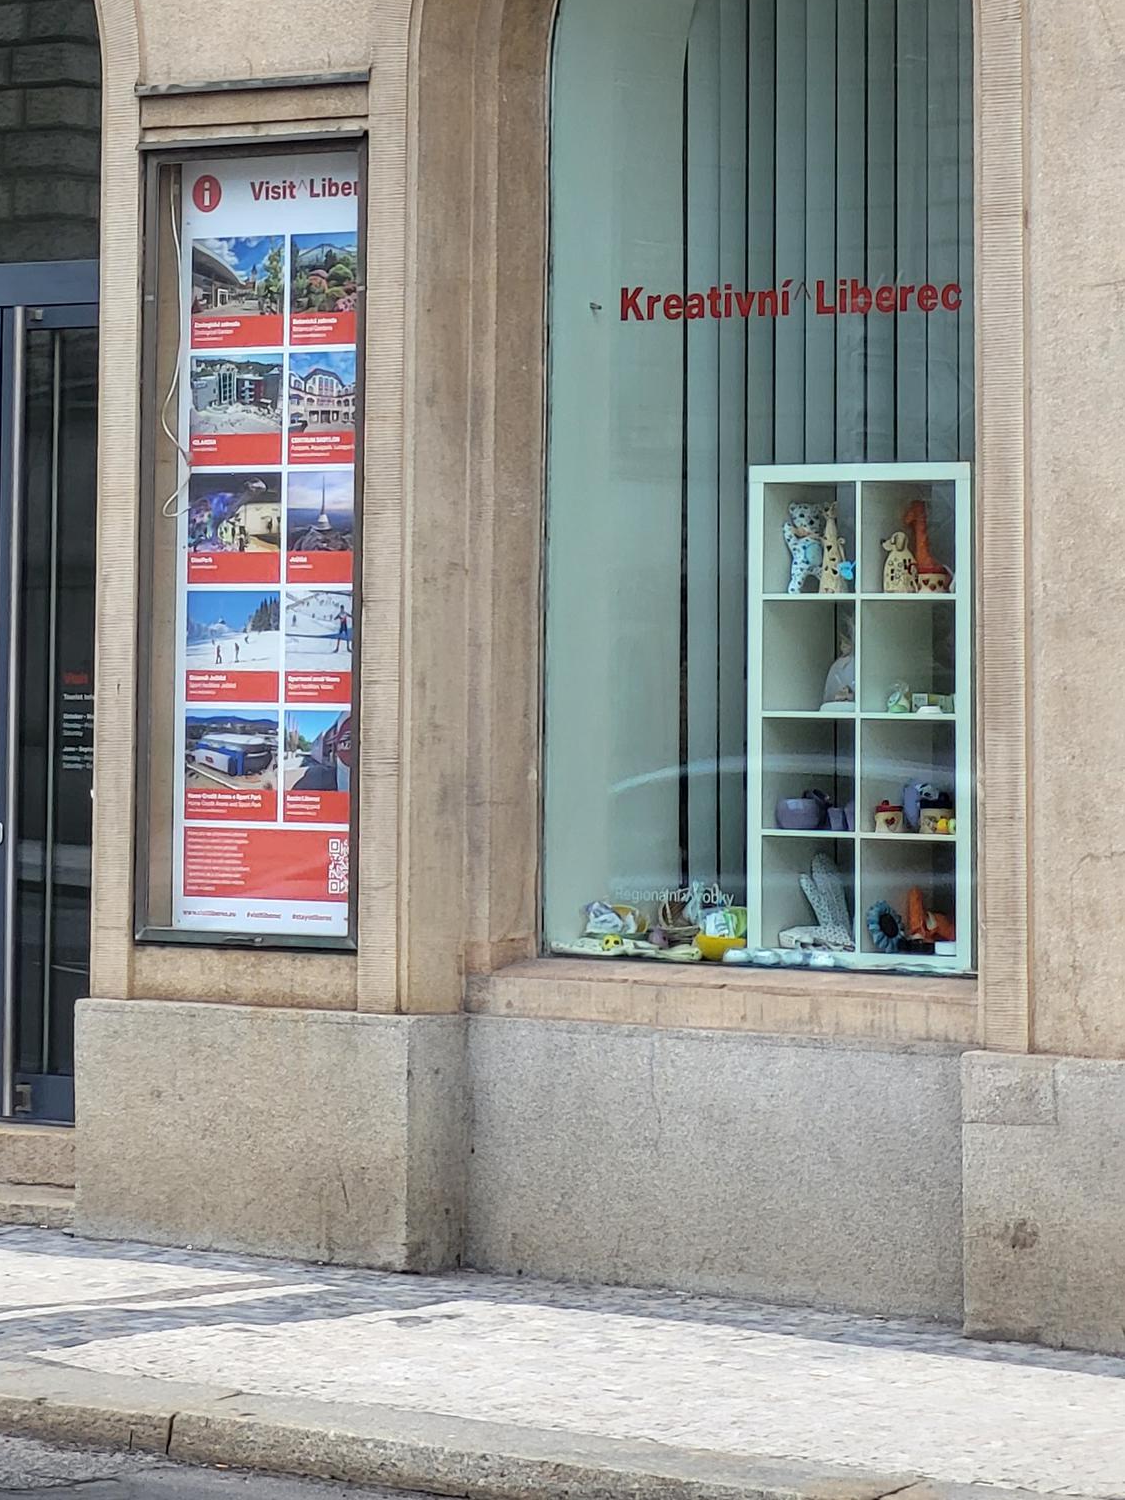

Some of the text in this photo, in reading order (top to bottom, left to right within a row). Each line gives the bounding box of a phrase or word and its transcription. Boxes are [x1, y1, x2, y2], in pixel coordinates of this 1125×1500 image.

[250, 180, 296, 200] Visit
[620, 279, 962, 321] Kreativní Liberec
